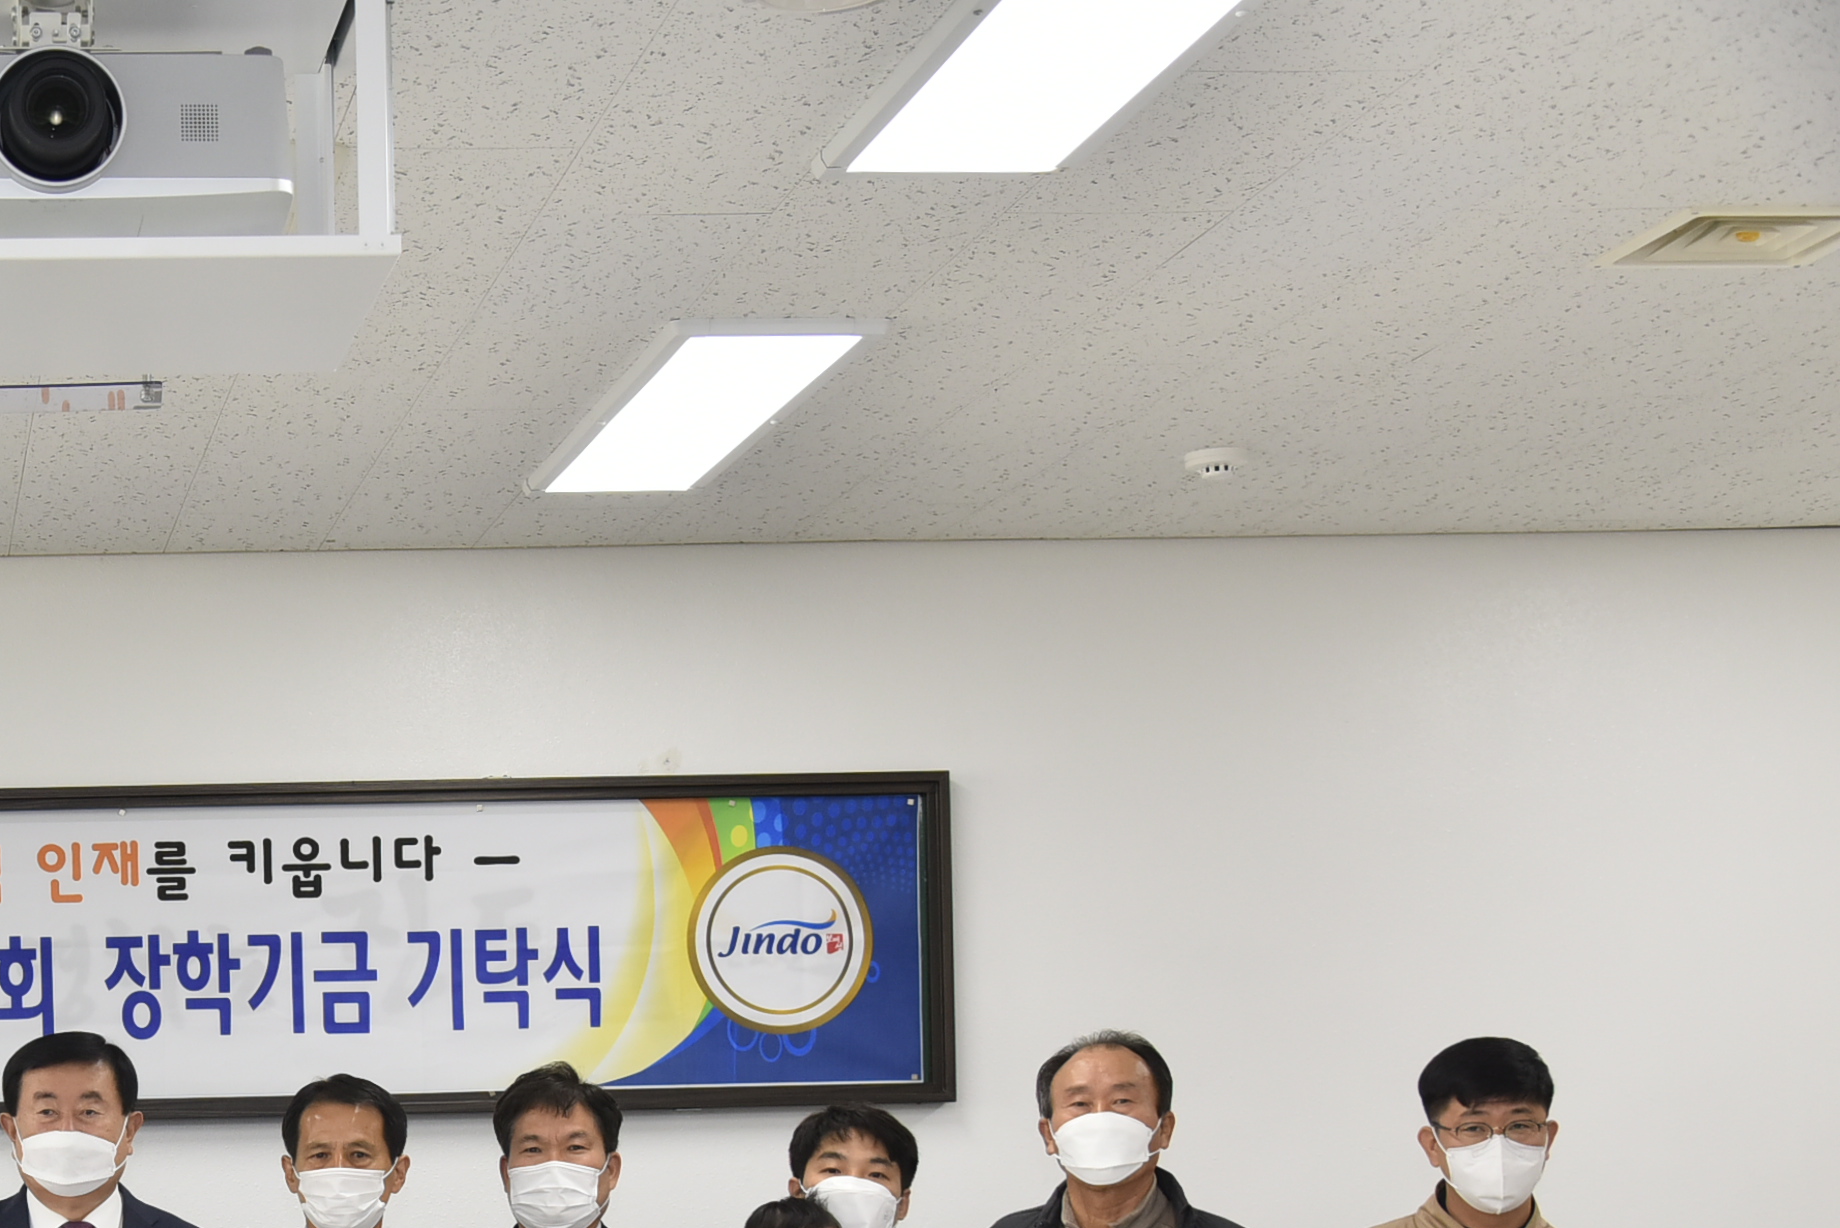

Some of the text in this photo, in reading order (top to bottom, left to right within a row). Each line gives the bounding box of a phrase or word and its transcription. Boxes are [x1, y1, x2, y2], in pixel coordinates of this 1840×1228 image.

[37, 839, 196, 903] 인재를
[228, 835, 441, 899] 키웁니다
[717, 926, 823, 958] Jindo
[104, 930, 378, 1040] 장학기금
[407, 925, 602, 1030] 기탁식
